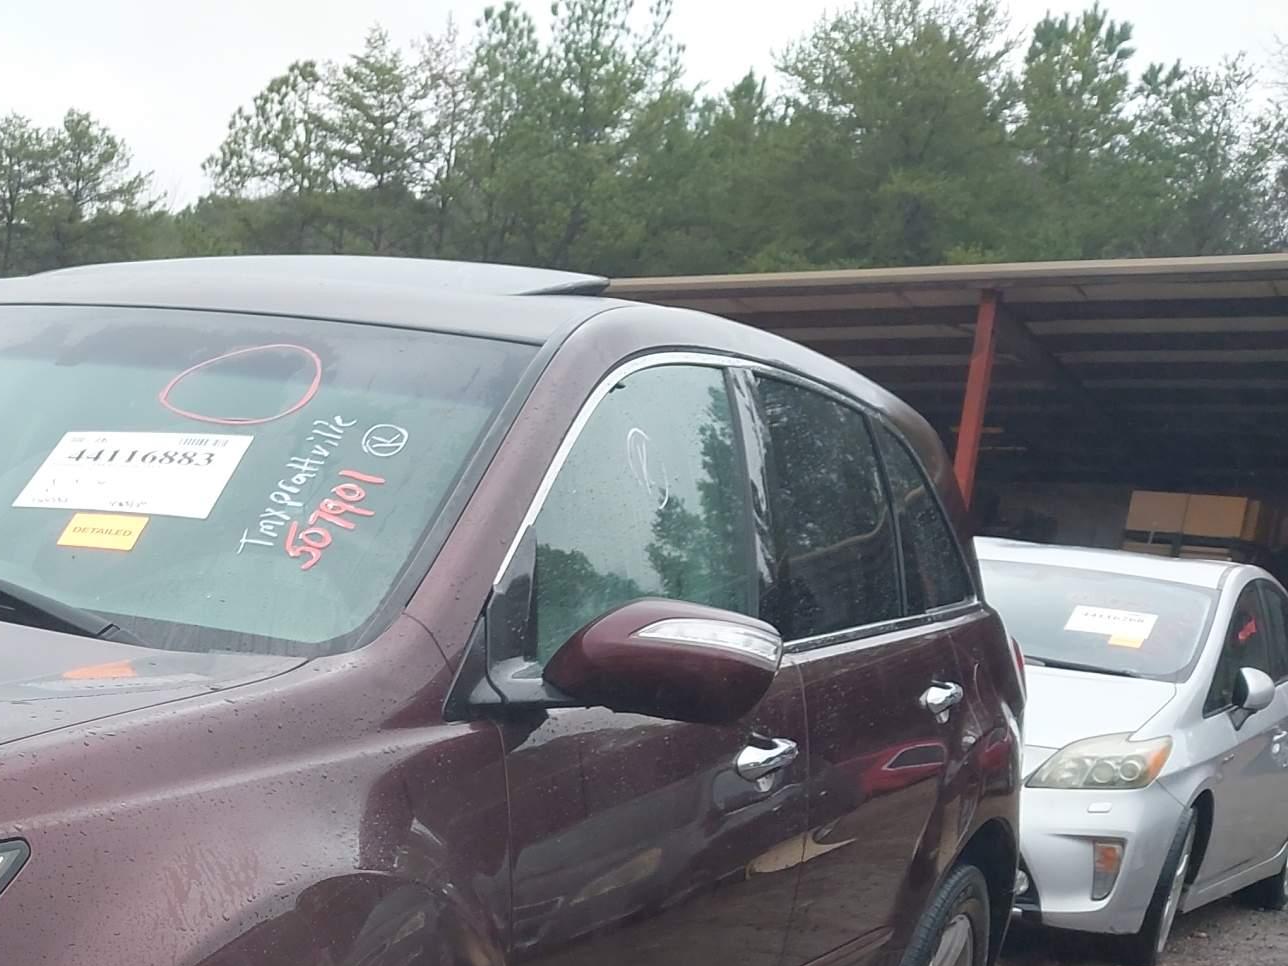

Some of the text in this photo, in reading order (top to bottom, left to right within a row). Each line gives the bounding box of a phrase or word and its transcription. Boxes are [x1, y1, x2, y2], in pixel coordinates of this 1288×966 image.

[65, 448, 216, 467] 44116883
[284, 469, 386, 571] 507901
[71, 525, 133, 538] DETAILED
